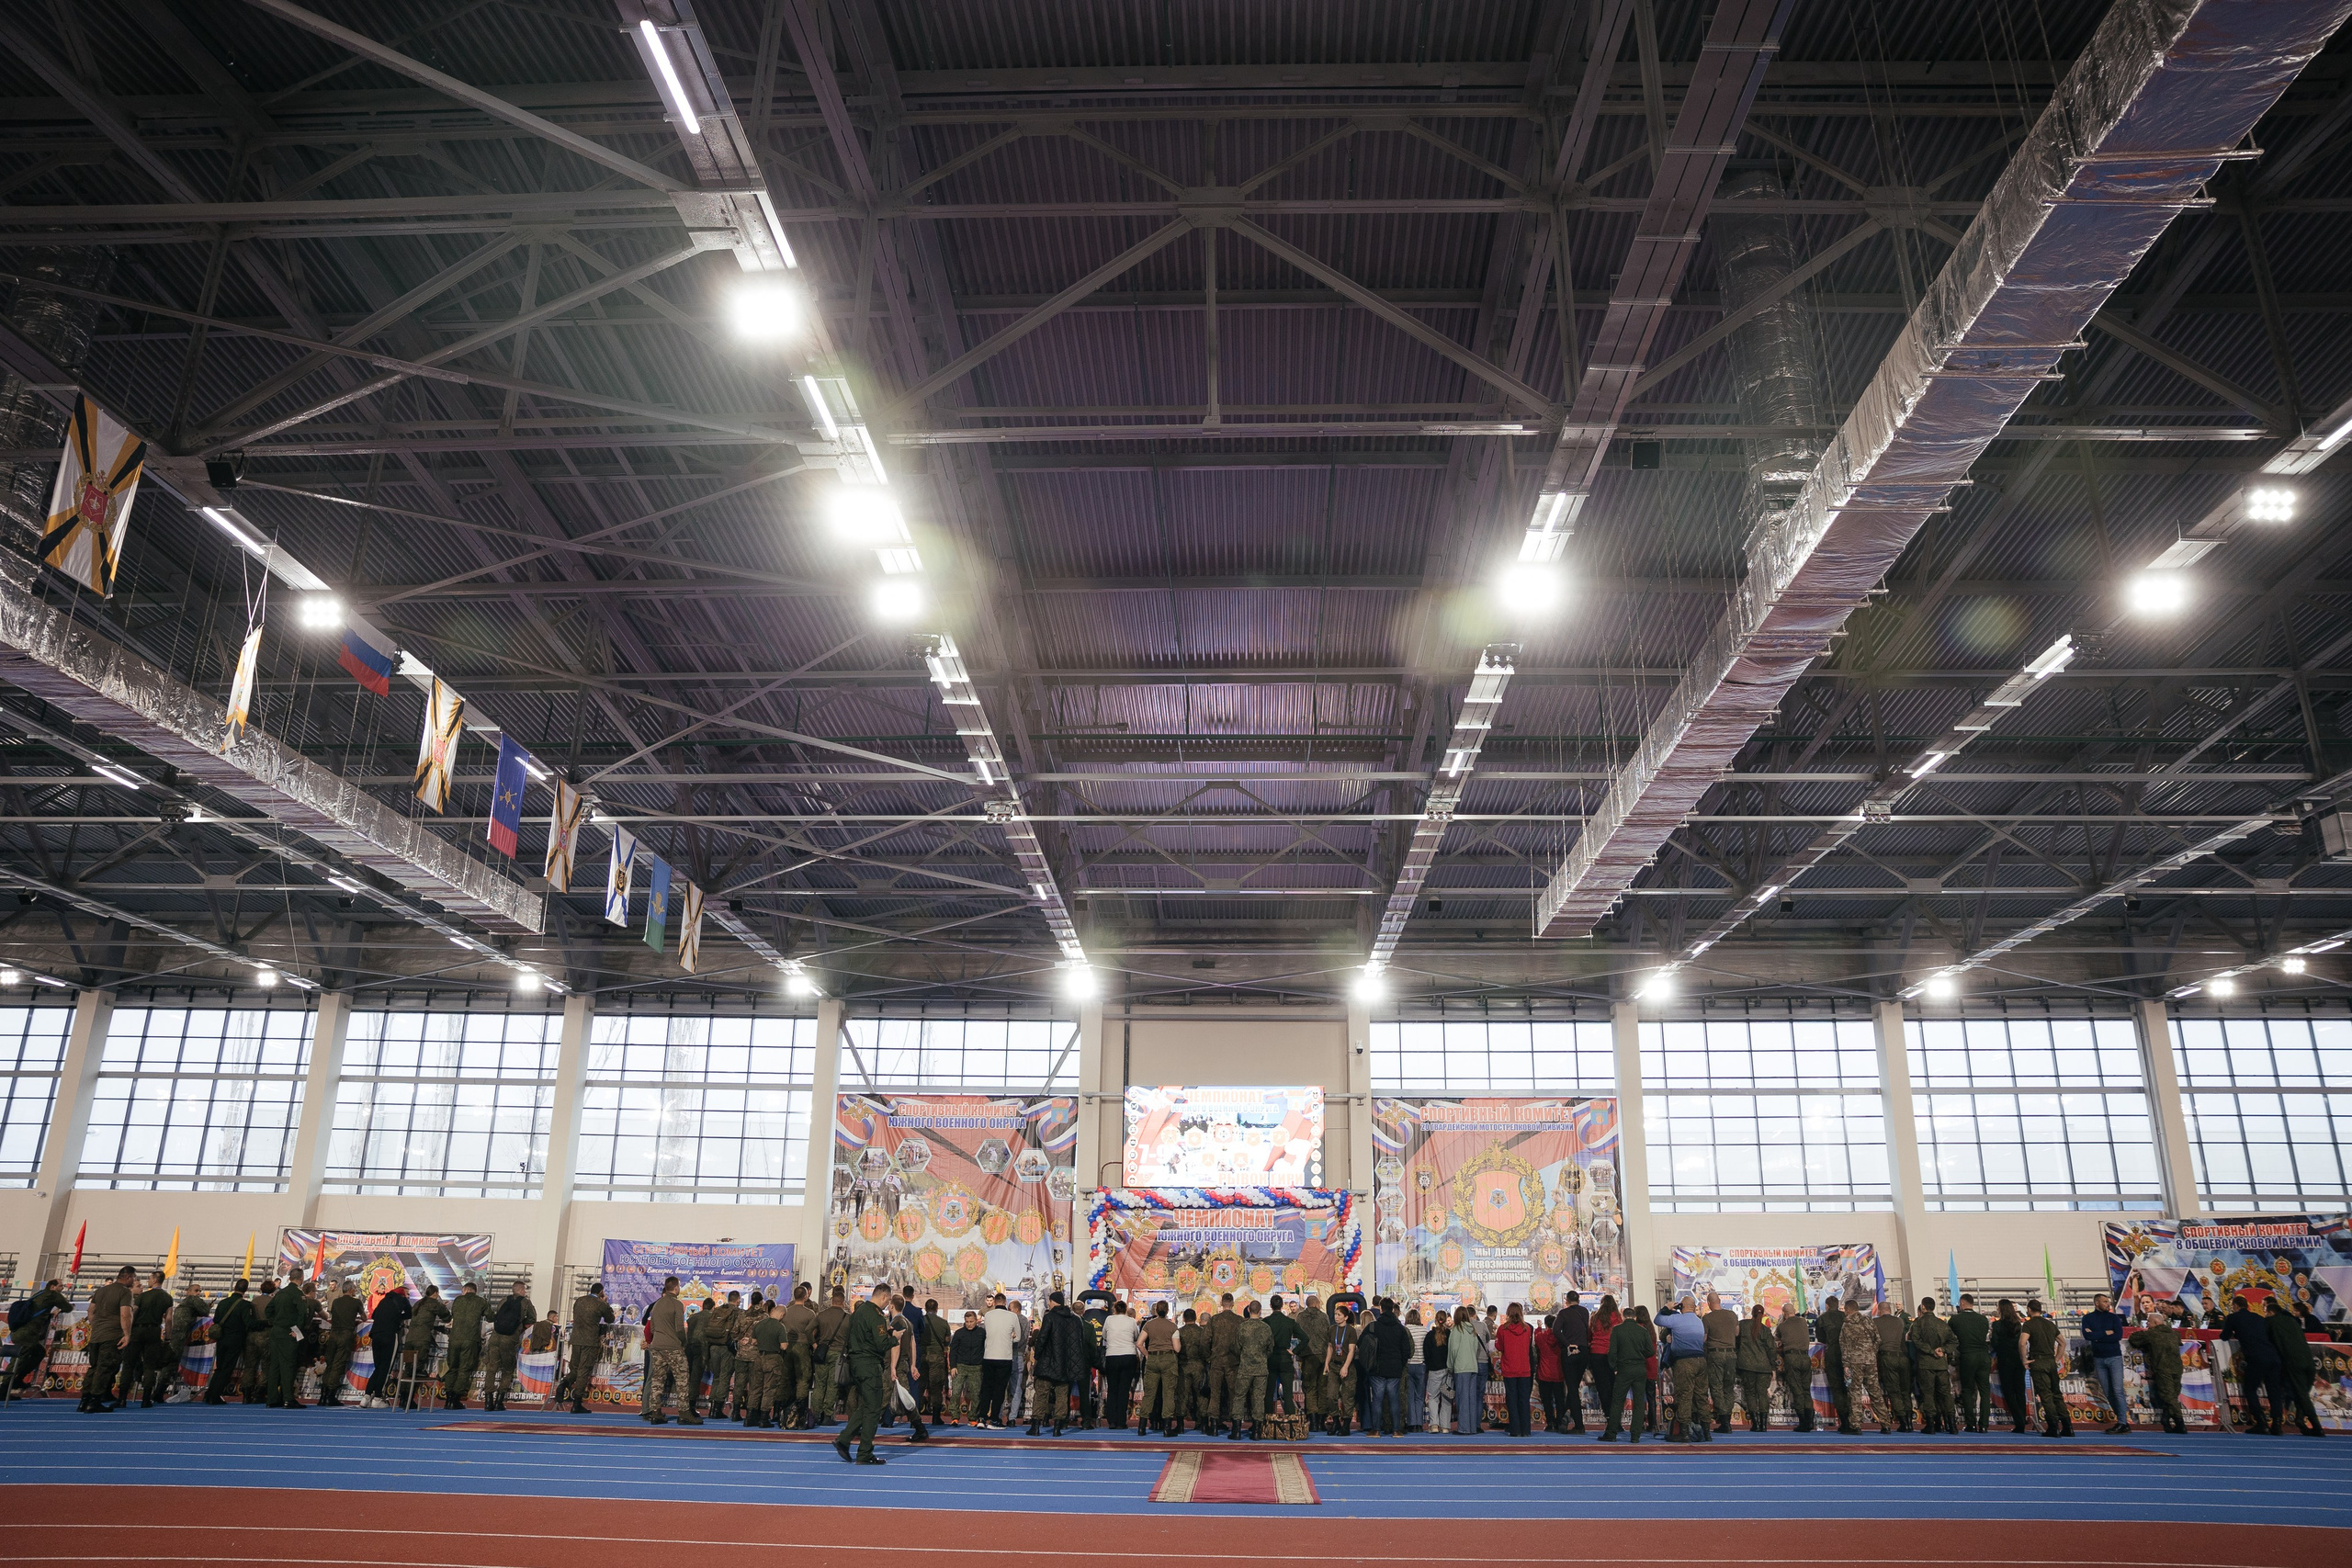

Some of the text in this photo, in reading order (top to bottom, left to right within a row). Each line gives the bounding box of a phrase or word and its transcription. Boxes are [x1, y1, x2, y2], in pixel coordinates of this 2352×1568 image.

[1185, 1090, 1263, 1103] ЧЕМПИОНАТ
[899, 1103, 1018, 1117] СПОРТИВНЫЙ КОМИТЕТ
[1171, 1104, 1279, 1112] ЮЖНОГО ВОЕННОГО ОКРУГА
[1419, 1104, 1574, 1122] СПОРТИВНЫЙ КОМИТЕТ
[888, 1116, 1026, 1129] ЮЖНОГО ВОЕННОГО ОКРУГА
[1420, 1122, 1575, 1132] 20 ГВАРДЕЙСКОЙ МОТОСТРЕЛКОВОЙ ДИВИЗИИ
[1218, 1172, 1304, 1186] РЫВОК ГИРИ
[1173, 1208, 1277, 1228] ЧЕМПИОНАТ
[1157, 1230, 1295, 1242] ЮЖНОГО ВОЕННОГО ОКРУГА
[2183, 1223, 2309, 1237] СПОРТИВНЫЙ КОМИТЕТ
[337, 1234, 439, 1247] СПОРТИВНЫЙ КОМИТЕТ
[2177, 1235, 2322, 1250] 8 ОБЩЕВОЙСКОВОЙ АРМИИ
[632, 1245, 764, 1258] СПОРТИВНЫЙ КОМИТЕТ
[1494, 1247, 1529, 1258] ДЕЛАЕМ
[1729, 1247, 1817, 1258] СПОРТИВНЫЙ КОМИТЕТ
[619, 1254, 776, 1268] ЮЖНОГО ВОЕННОГО ОКРУГА
[1468, 1259, 1532, 1269] НЕВОЗМОЖНОЕ
[1729, 1258, 1797, 1268] ОБЩЕВОЙСКОВОЙ
[1799, 1258, 1826, 1267] АРМИИ
[605, 1273, 632, 1283] ВЫШЕ
[604, 1282, 664, 1293] АРМЕЙСКОГО
[741, 1293, 750, 1311] 1
[51, 1350, 90, 1364] ЮЖНЫ
[2059, 1377, 2086, 1393] НЫЙ
